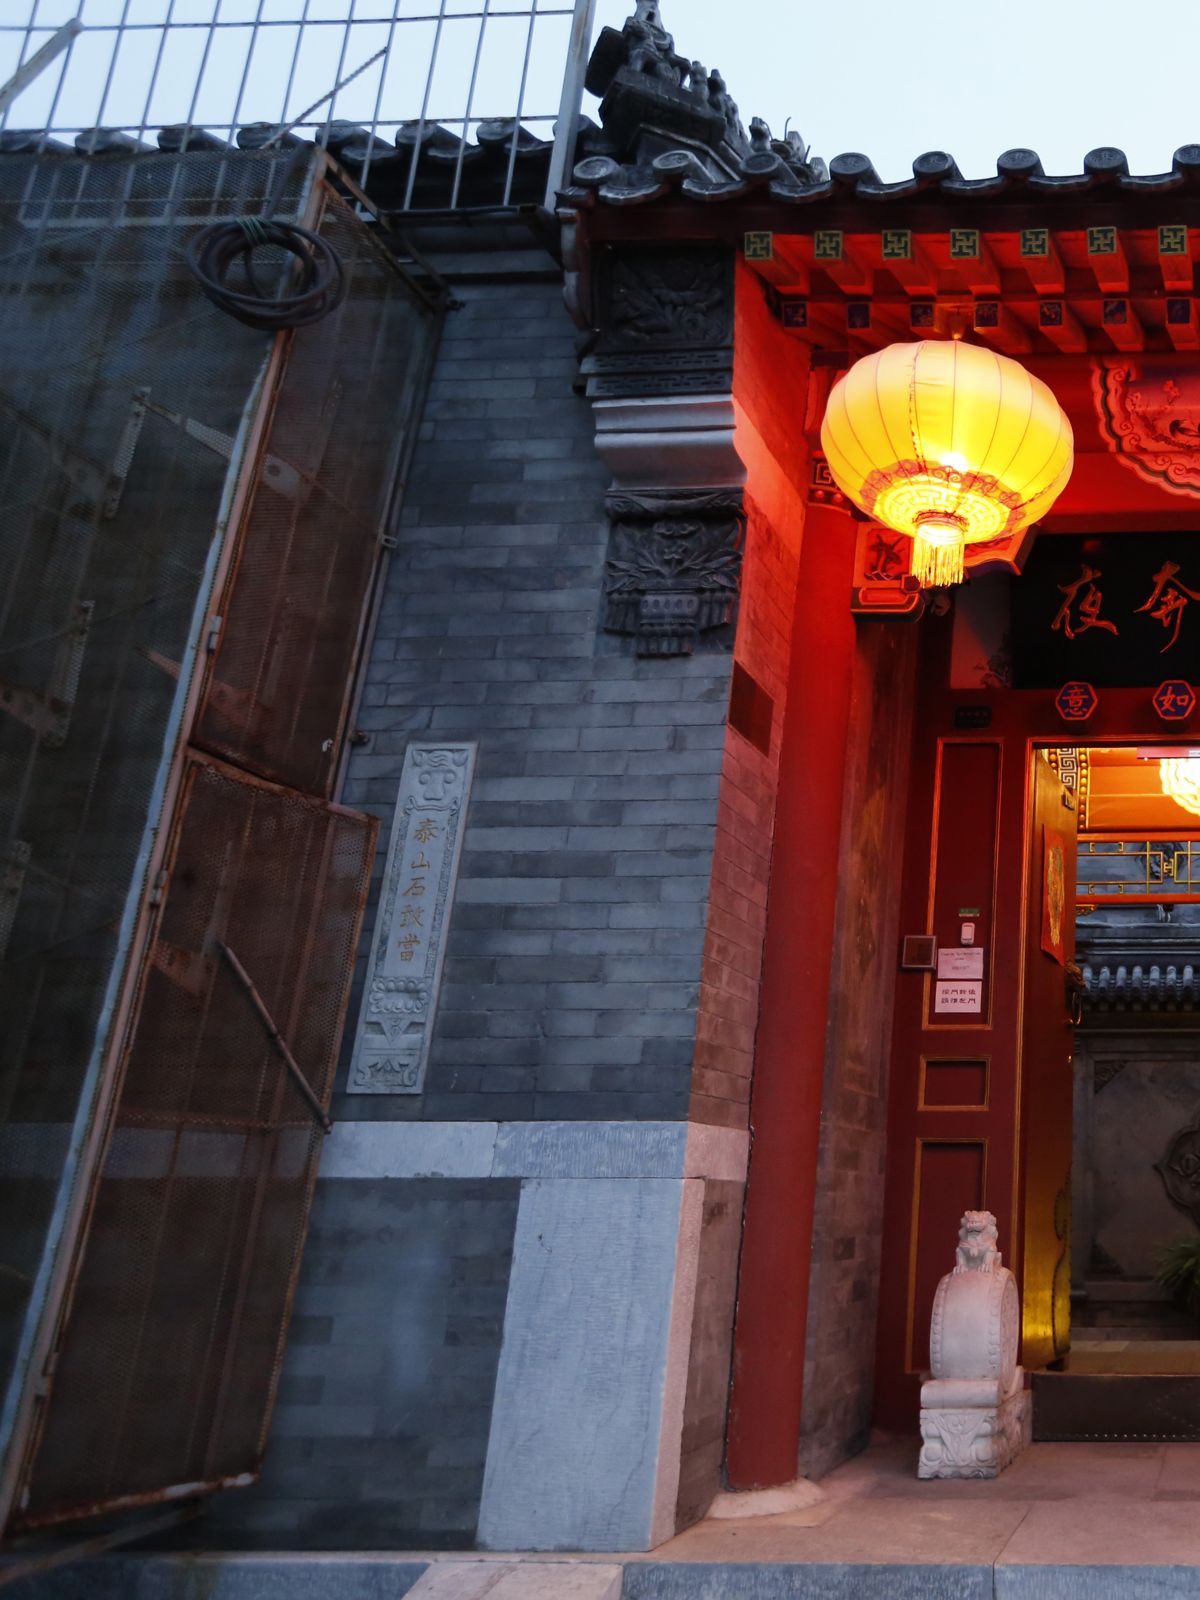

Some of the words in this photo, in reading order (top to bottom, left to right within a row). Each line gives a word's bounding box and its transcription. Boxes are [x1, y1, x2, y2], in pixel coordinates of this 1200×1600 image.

[397, 818, 440, 962] 泰山石敢當
